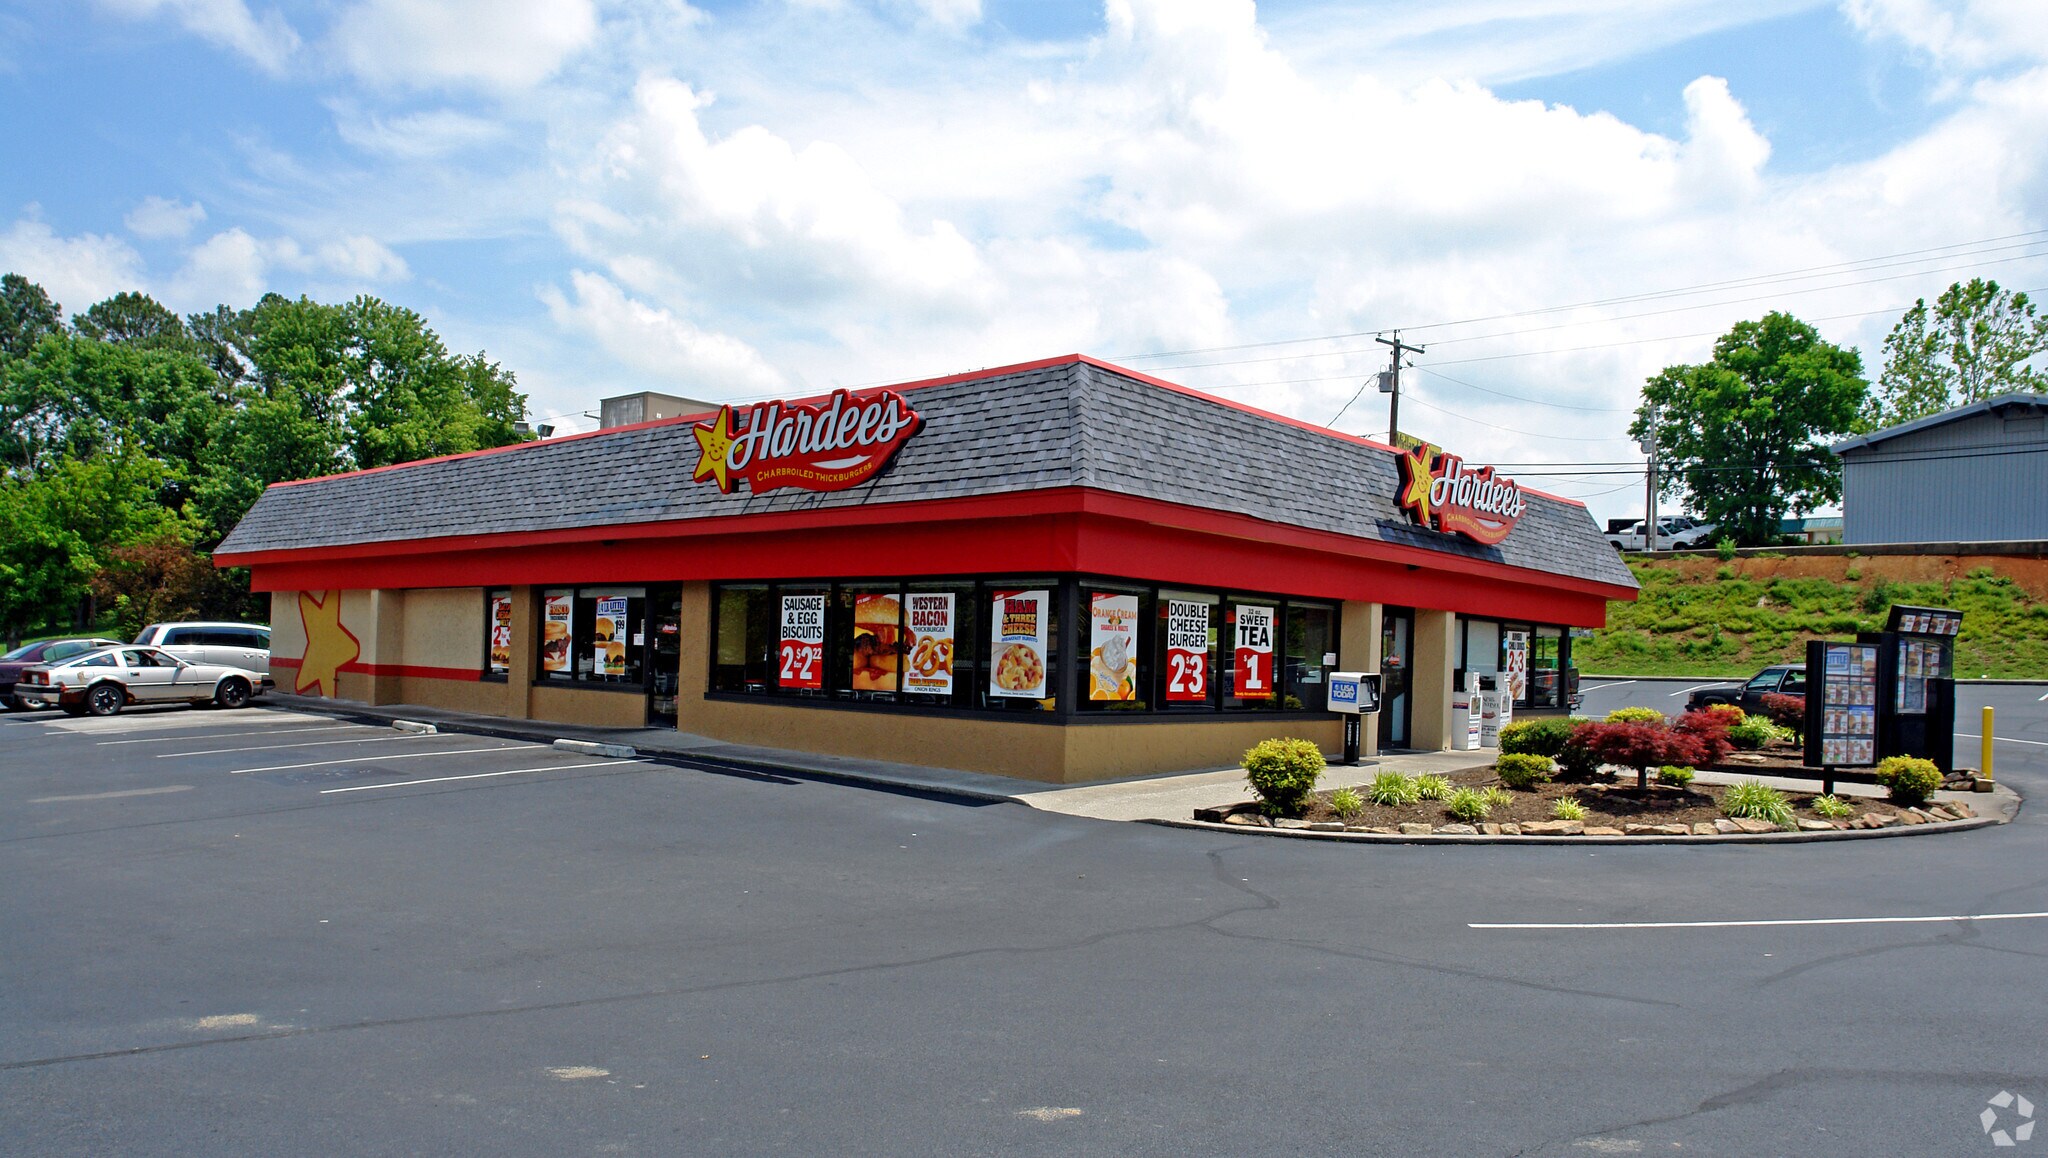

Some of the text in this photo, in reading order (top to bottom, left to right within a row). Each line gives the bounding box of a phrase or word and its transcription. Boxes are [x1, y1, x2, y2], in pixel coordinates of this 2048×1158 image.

[727, 391, 912, 470] Hardee's
[756, 462, 873, 482] CHARBROILED THICKBURGERS
[784, 597, 822, 611] SAUSAGE
[912, 596, 948, 611] WESTERN
[1004, 599, 1038, 613] HAM
[1170, 602, 1206, 618] DOUBLE
[787, 612, 818, 625] & EGG
[912, 610, 948, 627] BACON
[1002, 614, 1037, 624] & THREE
[1093, 608, 1137, 620] ORANGE CREAM
[1240, 614, 1269, 626] SWEET
[782, 626, 823, 639] BISCUITS
[1001, 623, 1037, 636] CHEESE
[1170, 618, 1206, 633] CHEESE
[494, 626, 501, 645] 2
[1169, 633, 1206, 647] BURGER
[1239, 625, 1270, 646] TEA
[781, 645, 794, 679] 2
[794, 660, 803, 670] for
[1509, 651, 1515, 672] 2
[1169, 654, 1185, 692] 2
[1237, 654, 1262, 689] $1
[1333, 690, 1355, 699] TODAY
[1340, 684, 1355, 692] USA
